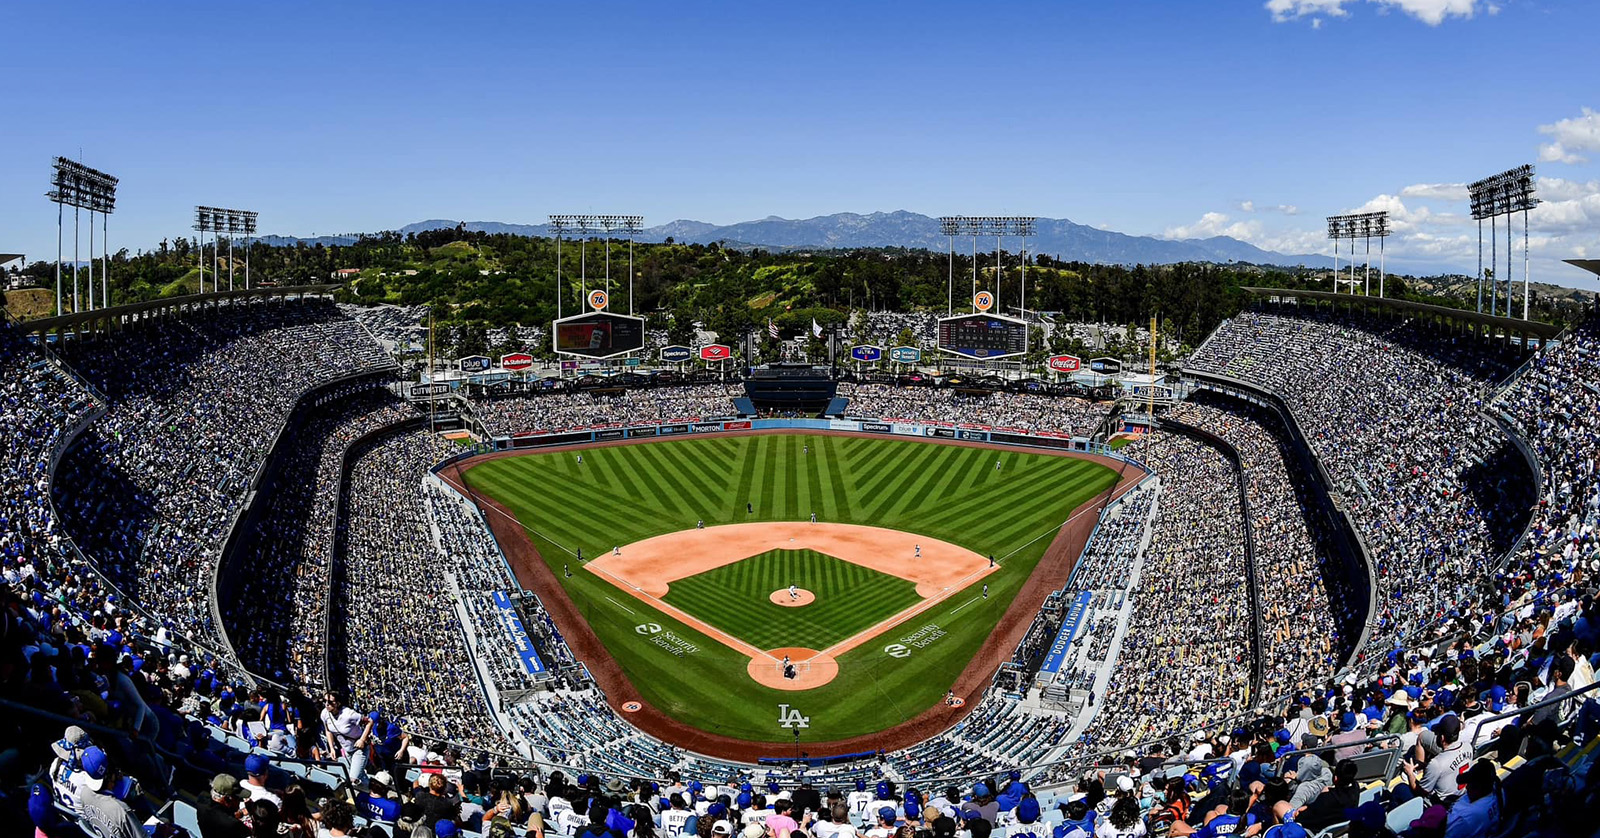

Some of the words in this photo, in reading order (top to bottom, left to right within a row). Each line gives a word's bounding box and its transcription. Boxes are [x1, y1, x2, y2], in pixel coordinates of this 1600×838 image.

[594, 296, 604, 304] 76
[978, 297, 989, 305] 76
[463, 360, 480, 368] blue
[1051, 359, 1077, 369] Coca-Cola
[412, 385, 448, 395] CUTWATER
[695, 425, 720, 433] MORTON
[863, 423, 889, 431] Spectrum
[900, 622, 940, 644] Security
[1052, 628, 1072, 655] DODGER
[1065, 603, 1084, 627] STADIUM
[661, 630, 700, 654] Security
[911, 630, 948, 649] Benefit
[650, 635, 683, 657] Benefit
[778, 704, 809, 728] LA
[857, 800, 868, 812] 17
[567, 814, 587, 826] OHTANI
